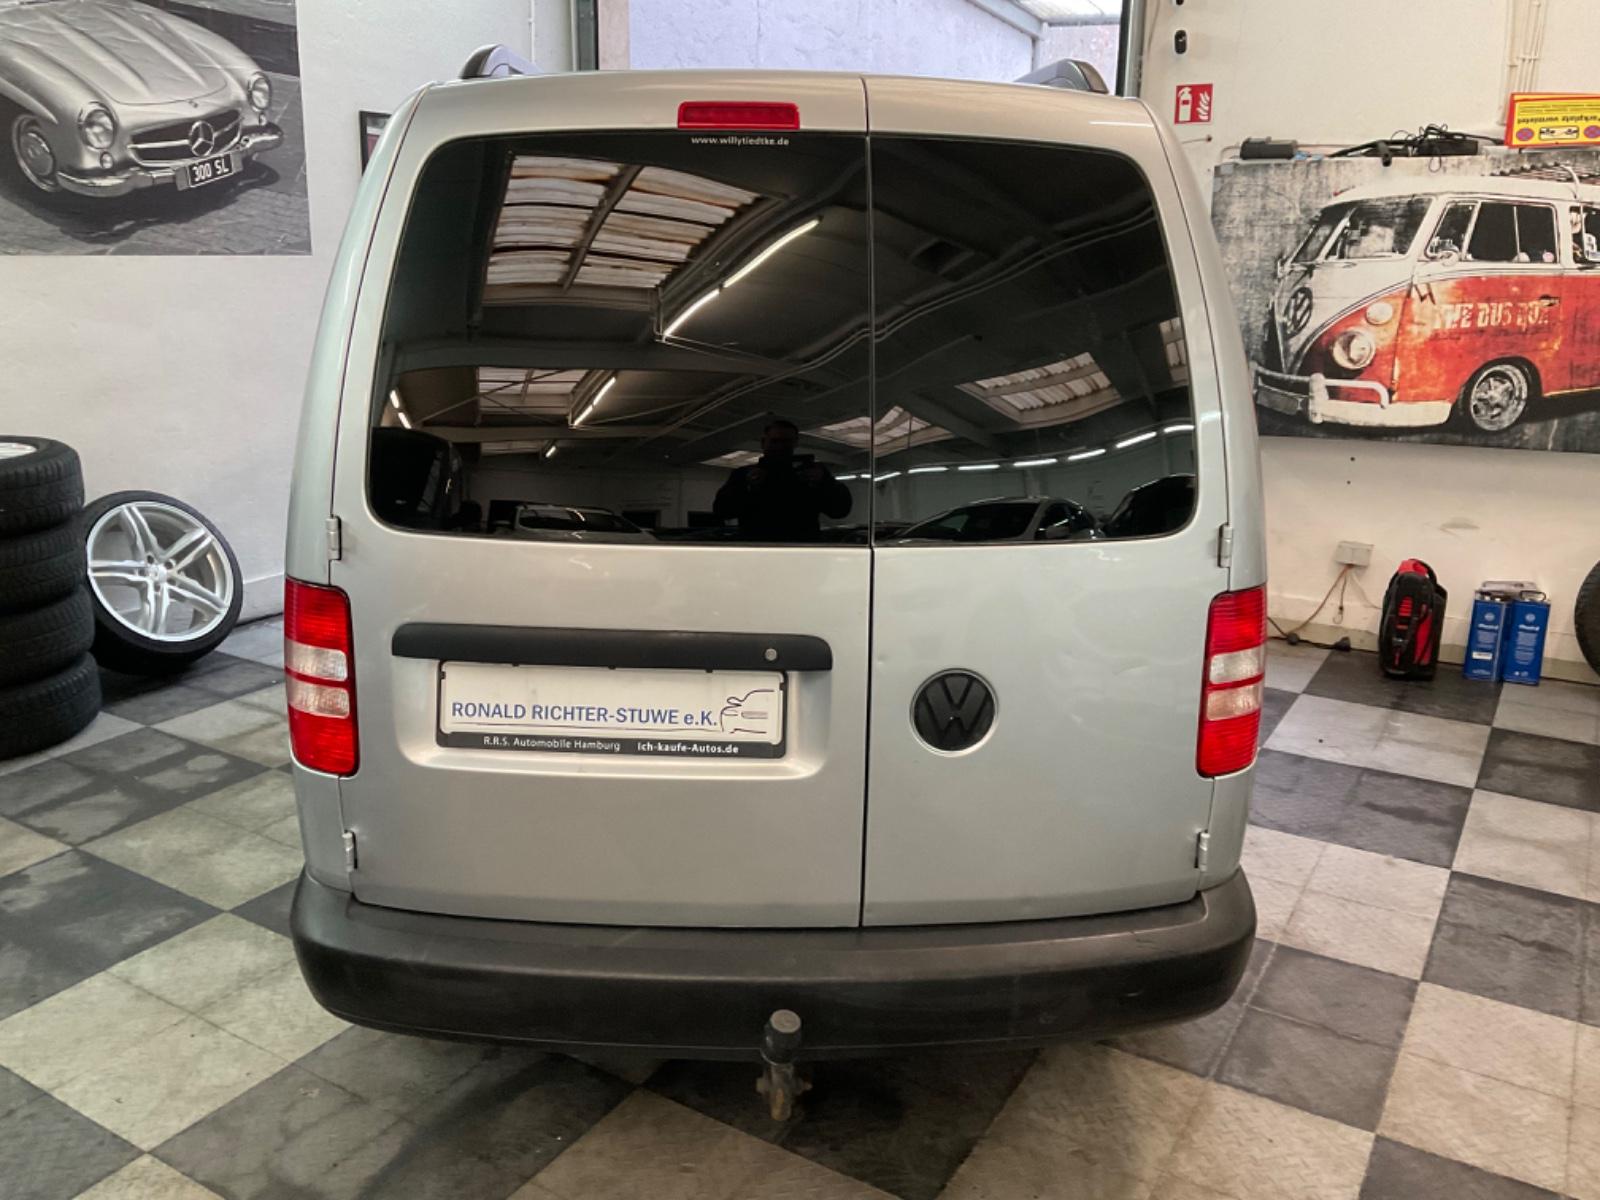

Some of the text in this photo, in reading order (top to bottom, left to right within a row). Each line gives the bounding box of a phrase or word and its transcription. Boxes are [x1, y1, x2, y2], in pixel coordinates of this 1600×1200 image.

[690, 136, 790, 146] www.willytiedtke.de
[192, 158, 230, 182] 300 SL
[451, 701, 718, 727] RONALD RICHTER-STUWE e.K.
[483, 735, 621, 753] R.R.S. Automobile Hamburg
[637, 742, 740, 755] Ich-kaufe-Autos.de
